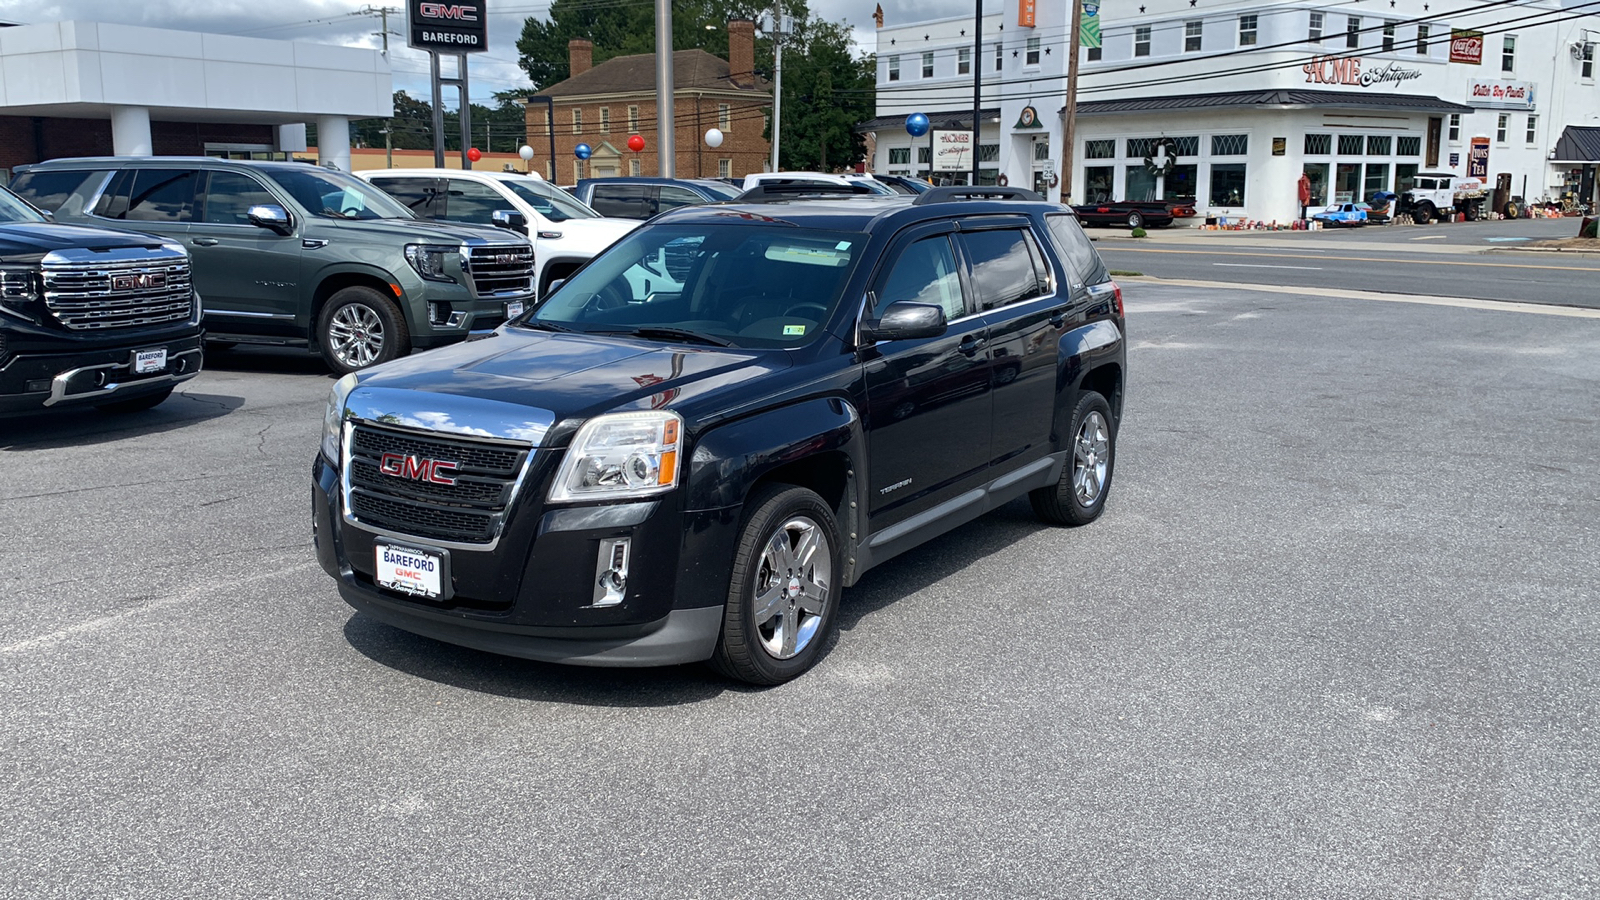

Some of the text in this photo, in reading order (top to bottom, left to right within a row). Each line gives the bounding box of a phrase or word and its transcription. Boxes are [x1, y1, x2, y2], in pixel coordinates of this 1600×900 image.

[420, 3, 477, 20] GMC
[422, 31, 478, 45] BAREFORD
[1303, 55, 1422, 88] ACME Antiques
[1473, 84, 1525, 99] Dutch Boy Paints
[1472, 163, 1485, 175] TEA
[114, 273, 165, 289] GMC
[138, 352, 164, 360] BAREFORD
[380, 452, 460, 486] GMC
[384, 551, 434, 572] BAREFORD
[395, 567, 421, 580] GMC
